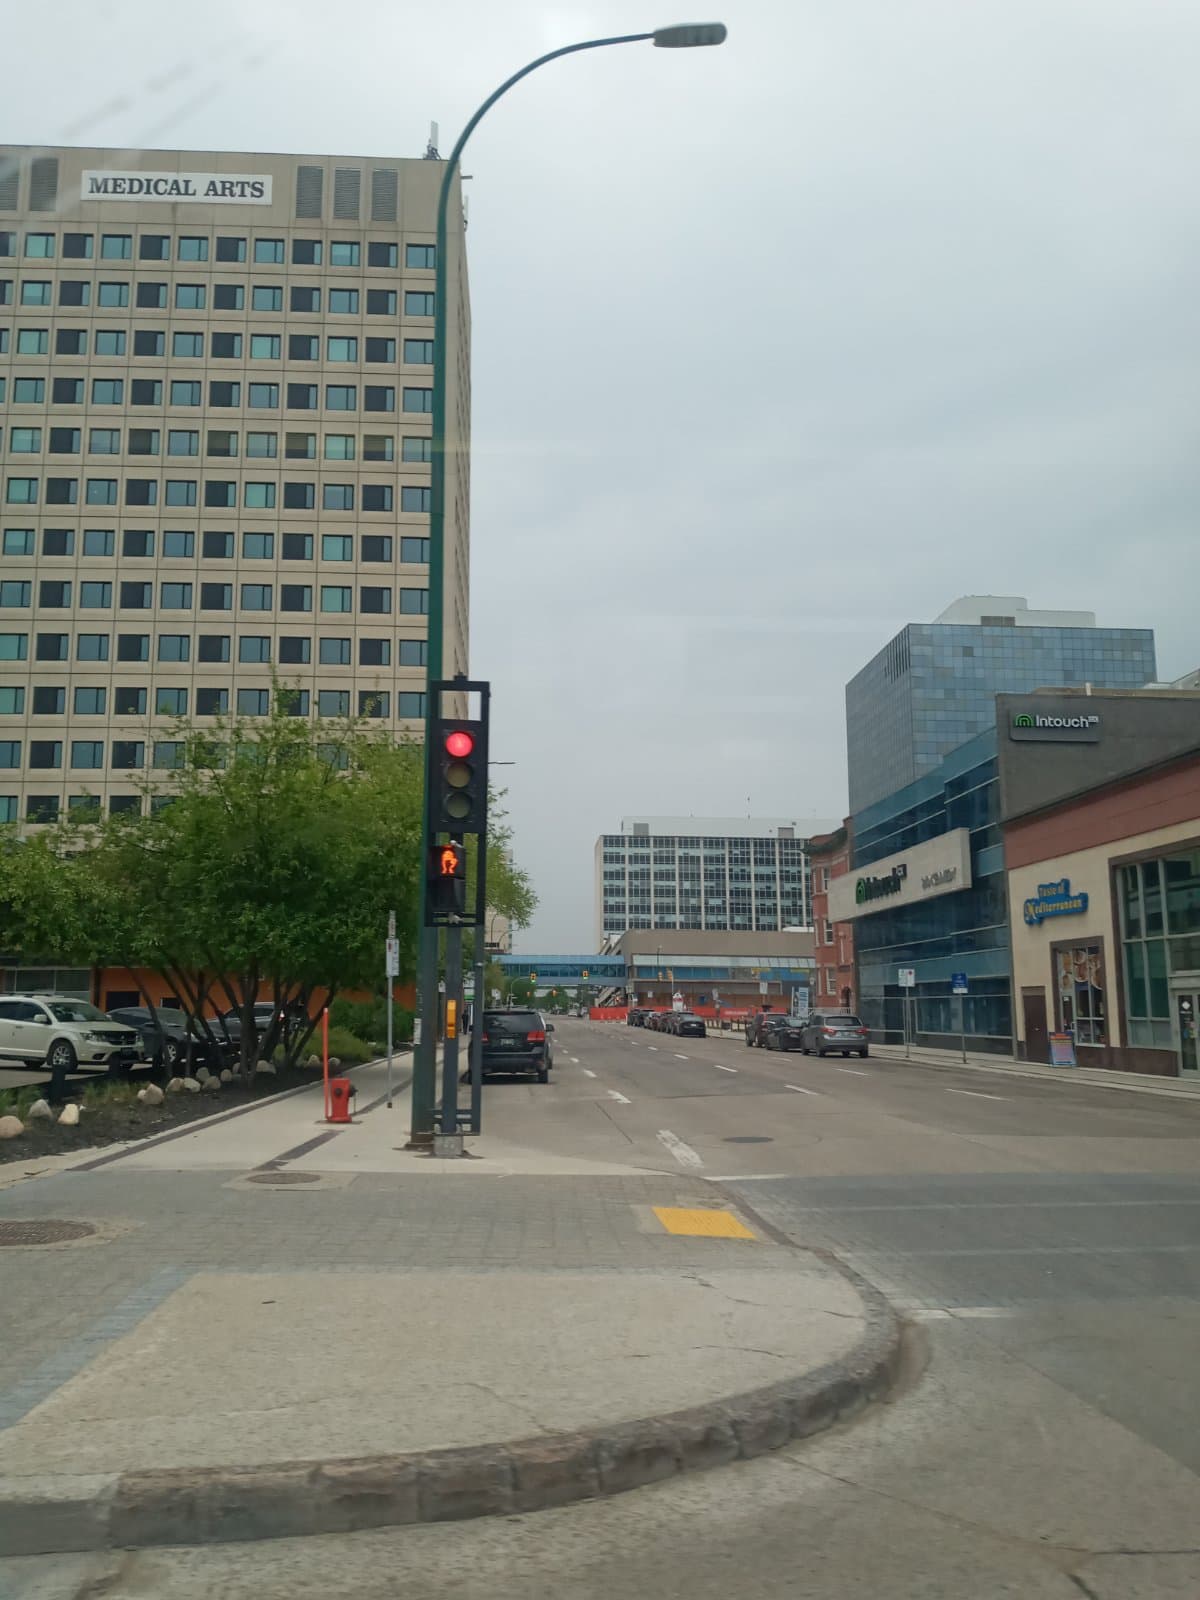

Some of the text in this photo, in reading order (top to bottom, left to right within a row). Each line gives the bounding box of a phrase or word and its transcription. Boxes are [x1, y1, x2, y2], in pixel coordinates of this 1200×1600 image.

[89, 177, 265, 198] MEDICAL ARTS
[1036, 715, 1089, 728] Intouch
[1039, 885, 1056, 897] Taste
